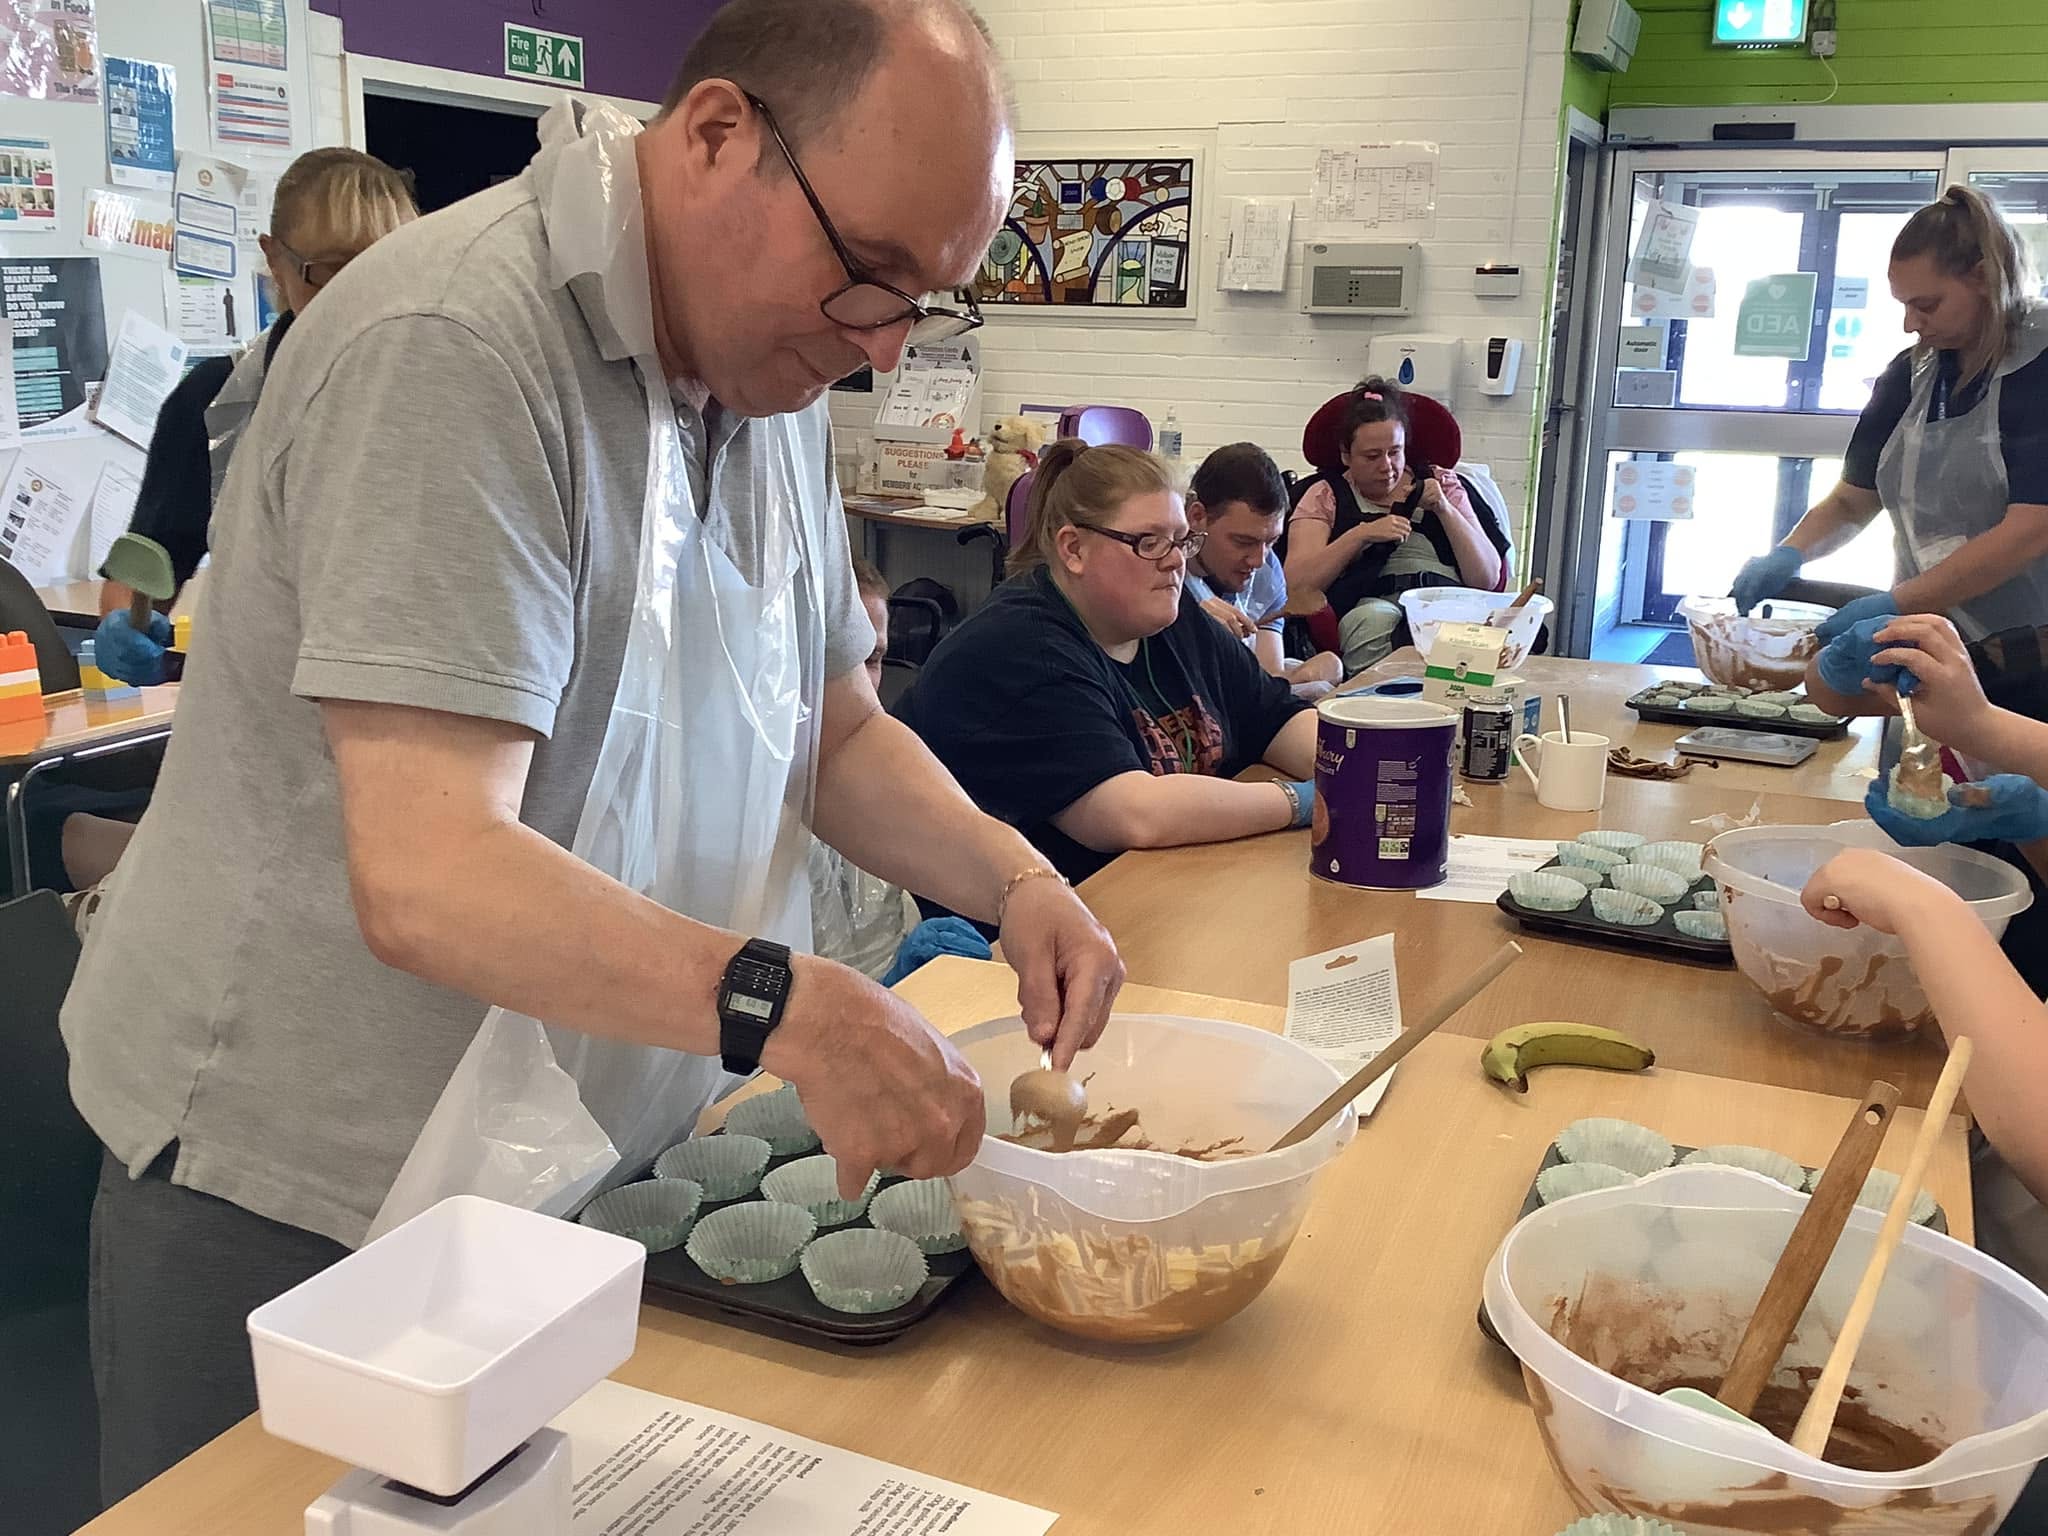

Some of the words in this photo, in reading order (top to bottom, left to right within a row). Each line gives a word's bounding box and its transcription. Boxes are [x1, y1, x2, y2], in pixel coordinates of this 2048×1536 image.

[511, 34, 529, 51] Fire
[511, 53, 528, 67] exit
[1, 266, 31, 274] THERE
[3, 275, 30, 283] MANY
[31, 274, 57, 283] SIGNS
[4, 284, 15, 292] OF
[6, 302, 19, 310] DO
[19, 301, 37, 310] YOU
[37, 301, 65, 309] KNOW
[28, 310, 42, 318] TO
[13, 318, 56, 328] ECOGNISE
[897, 460, 929, 470] PLEASE
[909, 471, 918, 479] for
[655, 1411, 671, 1422] wire
[642, 1422, 657, 1433] rack
[660, 1414, 682, 1433] skewer
[672, 1417, 695, 1434] Divide
[661, 1434, 676, 1443] the
[713, 1427, 728, 1438] just
[630, 1434, 645, 1445] and
[718, 1432, 741, 1448] vanilla
[736, 1434, 751, 1446] Add
[612, 1443, 634, 1457] leave
[692, 1438, 716, 1458] enough
[725, 1445, 740, 1455] the
[769, 1446, 788, 1459] beat
[605, 1457, 617, 1465] to
[697, 1448, 720, 1467] extract
[712, 1455, 728, 1468] eggs
[782, 1450, 798, 1462] with
[608, 1463, 625, 1473] the
[756, 1458, 773, 1471] with
[765, 1461, 785, 1478] paper
[796, 1457, 823, 1479] Method
[669, 1469, 682, 1477] to
[685, 1466, 700, 1477] and
[699, 1468, 714, 1479] one
[587, 1472, 612, 1491] middle
[604, 1480, 619, 1491] the
[671, 1477, 690, 1490] beat
[719, 1479, 734, 1491] and
[888, 1482, 908, 1497] 200g
[737, 1493, 752, 1503] Put
[926, 1494, 946, 1508] 200g
[642, 1506, 655, 1514] to
[723, 1503, 741, 1513] the
[742, 1502, 756, 1512] gas
[858, 1500, 873, 1512] milk
[886, 1498, 906, 1518] vanilla
[903, 1494, 927, 1517] medium
[939, 1497, 958, 1512] 200g
[910, 1507, 931, 1529] golden
[938, 1501, 971, 1533] Ingredients
[691, 1522, 705, 1530] by
[891, 1517, 909, 1531] free
